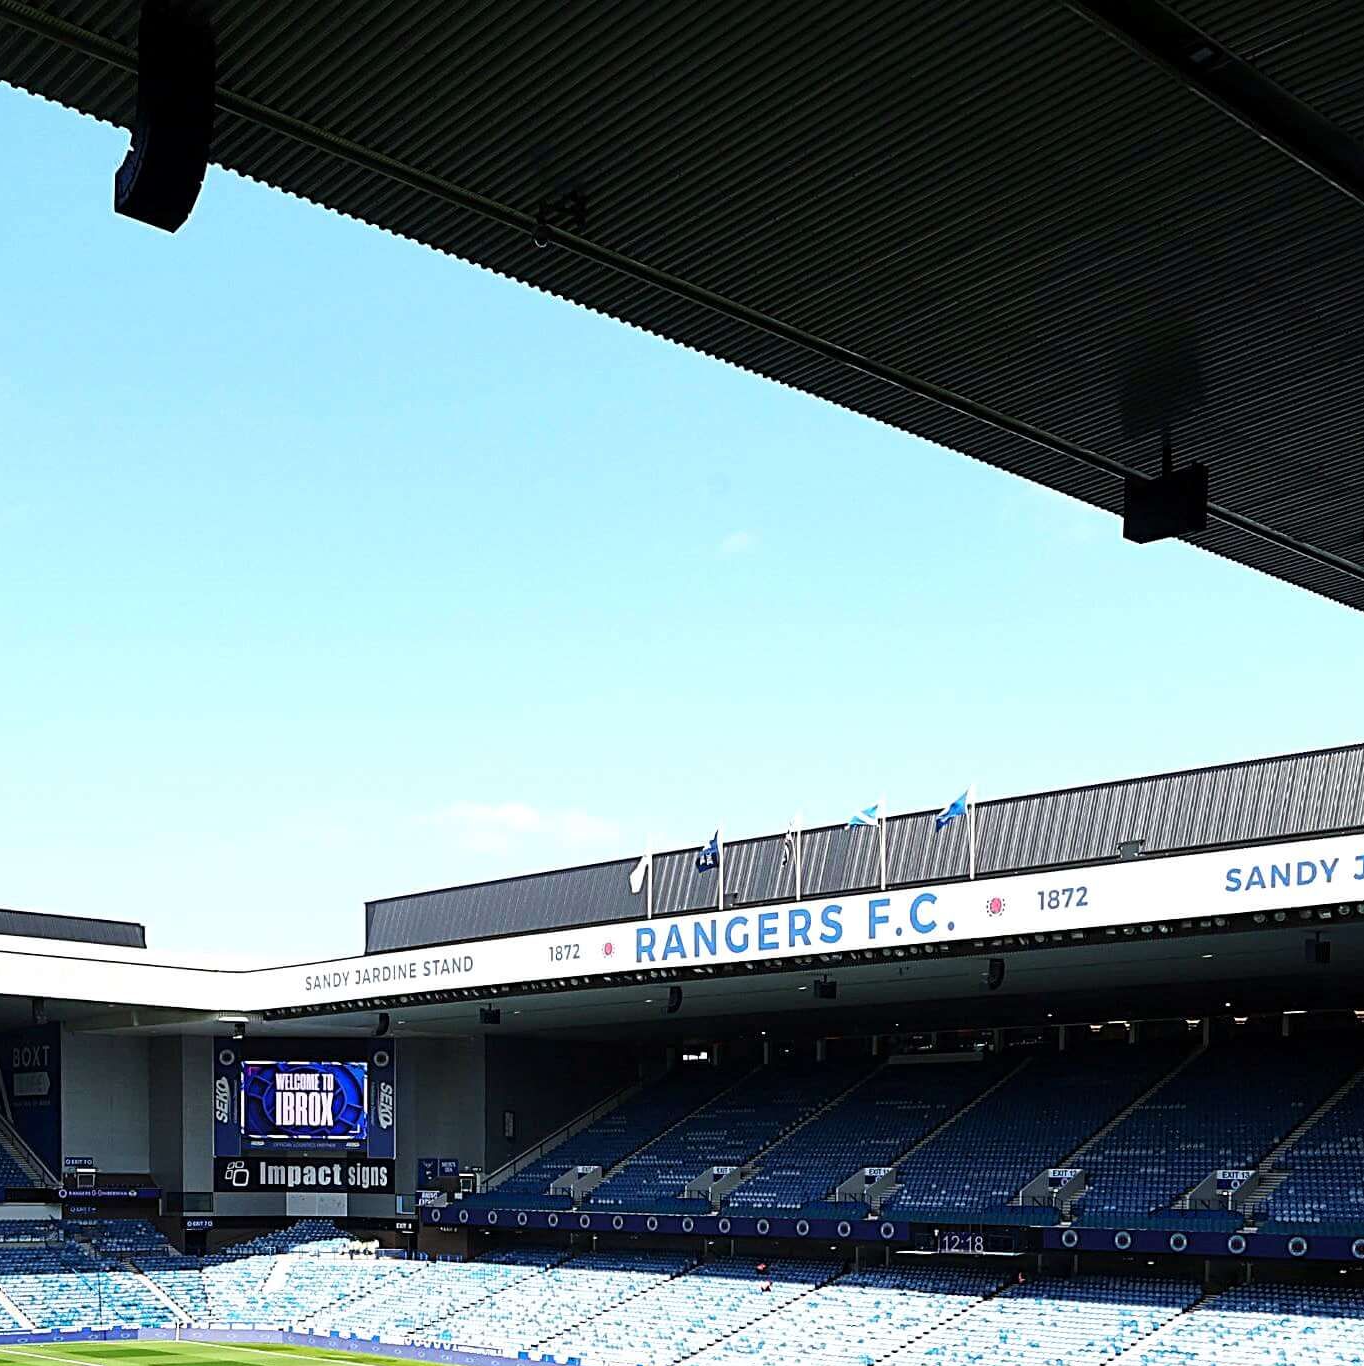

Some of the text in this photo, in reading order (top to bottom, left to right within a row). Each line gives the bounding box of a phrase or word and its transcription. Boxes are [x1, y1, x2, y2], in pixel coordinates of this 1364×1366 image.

[1225, 858, 1340, 893] SANDY
[1037, 886, 1088, 911] 1872
[636, 892, 956, 963] RANGERS F.C.
[548, 943, 580, 962] 1872
[304, 955, 474, 991] SANDY JARDINE STAND
[12, 1045, 50, 1067] BOXT
[275, 1073, 334, 1092] WELCOME TO
[215, 1076, 231, 1123] SEKO
[275, 1091, 334, 1127] IBROX
[378, 1082, 393, 1129] SEKO
[260, 1161, 388, 1189] Impact signs
[1222, 1171, 1240, 1179] EXIT
[943, 1235, 984, 1253] 12:18
